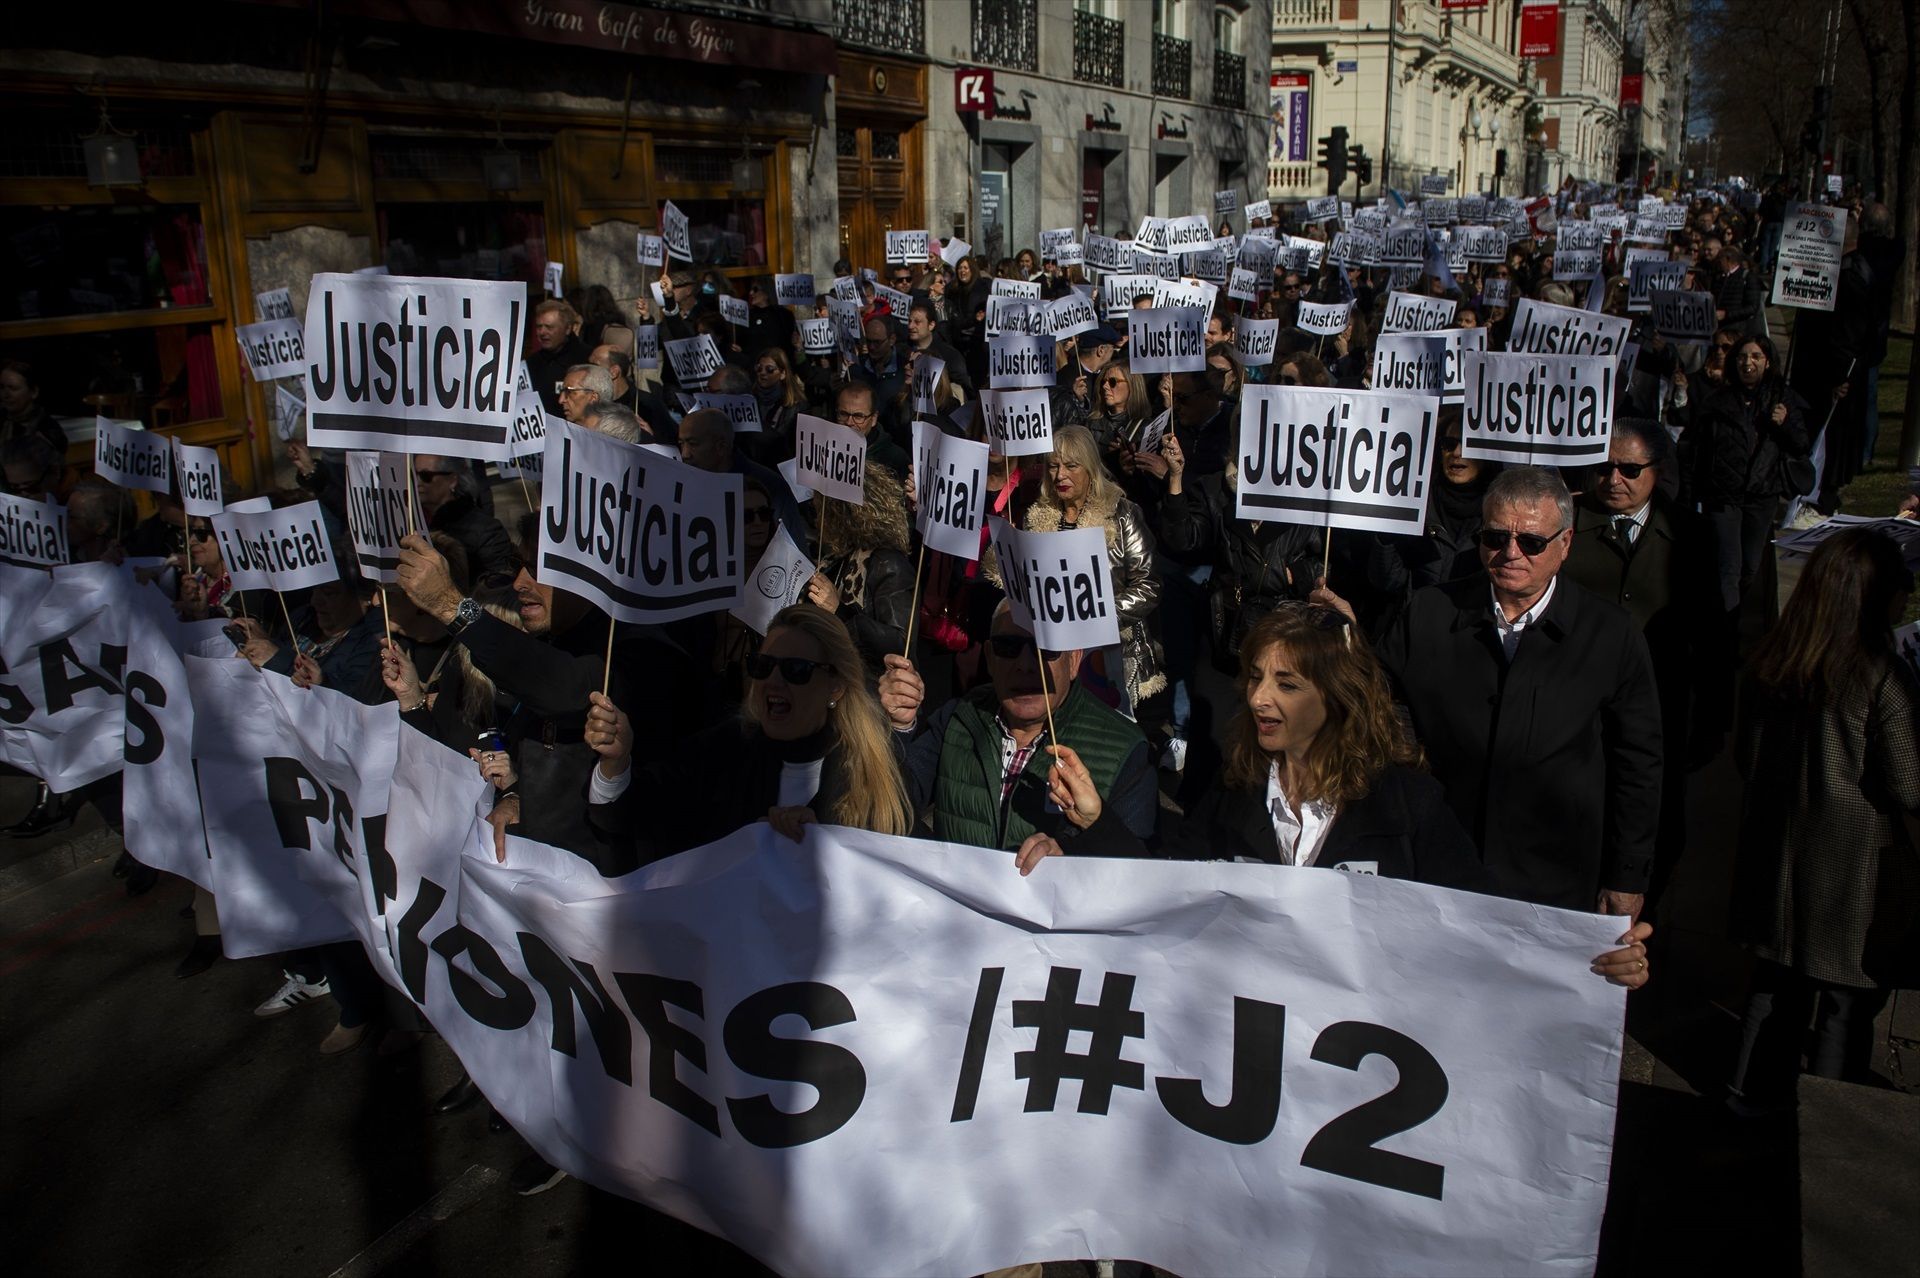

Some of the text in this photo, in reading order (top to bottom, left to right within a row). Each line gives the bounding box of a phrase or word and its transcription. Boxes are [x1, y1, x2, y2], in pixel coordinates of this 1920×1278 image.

[653, 17, 679, 44] de
[888, 233, 928, 255] Justicia!
[1168, 222, 1212, 246] ¡Justicia!
[1463, 233, 1508, 255] Justicia!
[1796, 220, 1817, 232] #J2
[1047, 301, 1095, 333] ¡Justicia!
[311, 291, 520, 414] Justicia!
[670, 339, 723, 377] Justicia!
[1132, 322, 1202, 358] ¡Justicia!
[992, 347, 1054, 377] ¡Justicia!
[1467, 362, 1611, 438] Justicia!
[97, 429, 167, 480] ¡Justicia!
[800, 431, 863, 487] ¡Justicia!
[1243, 399, 1432, 498] Justicia!
[546, 438, 737, 586] Justicia!
[221, 519, 328, 574] ¡Justicia!
